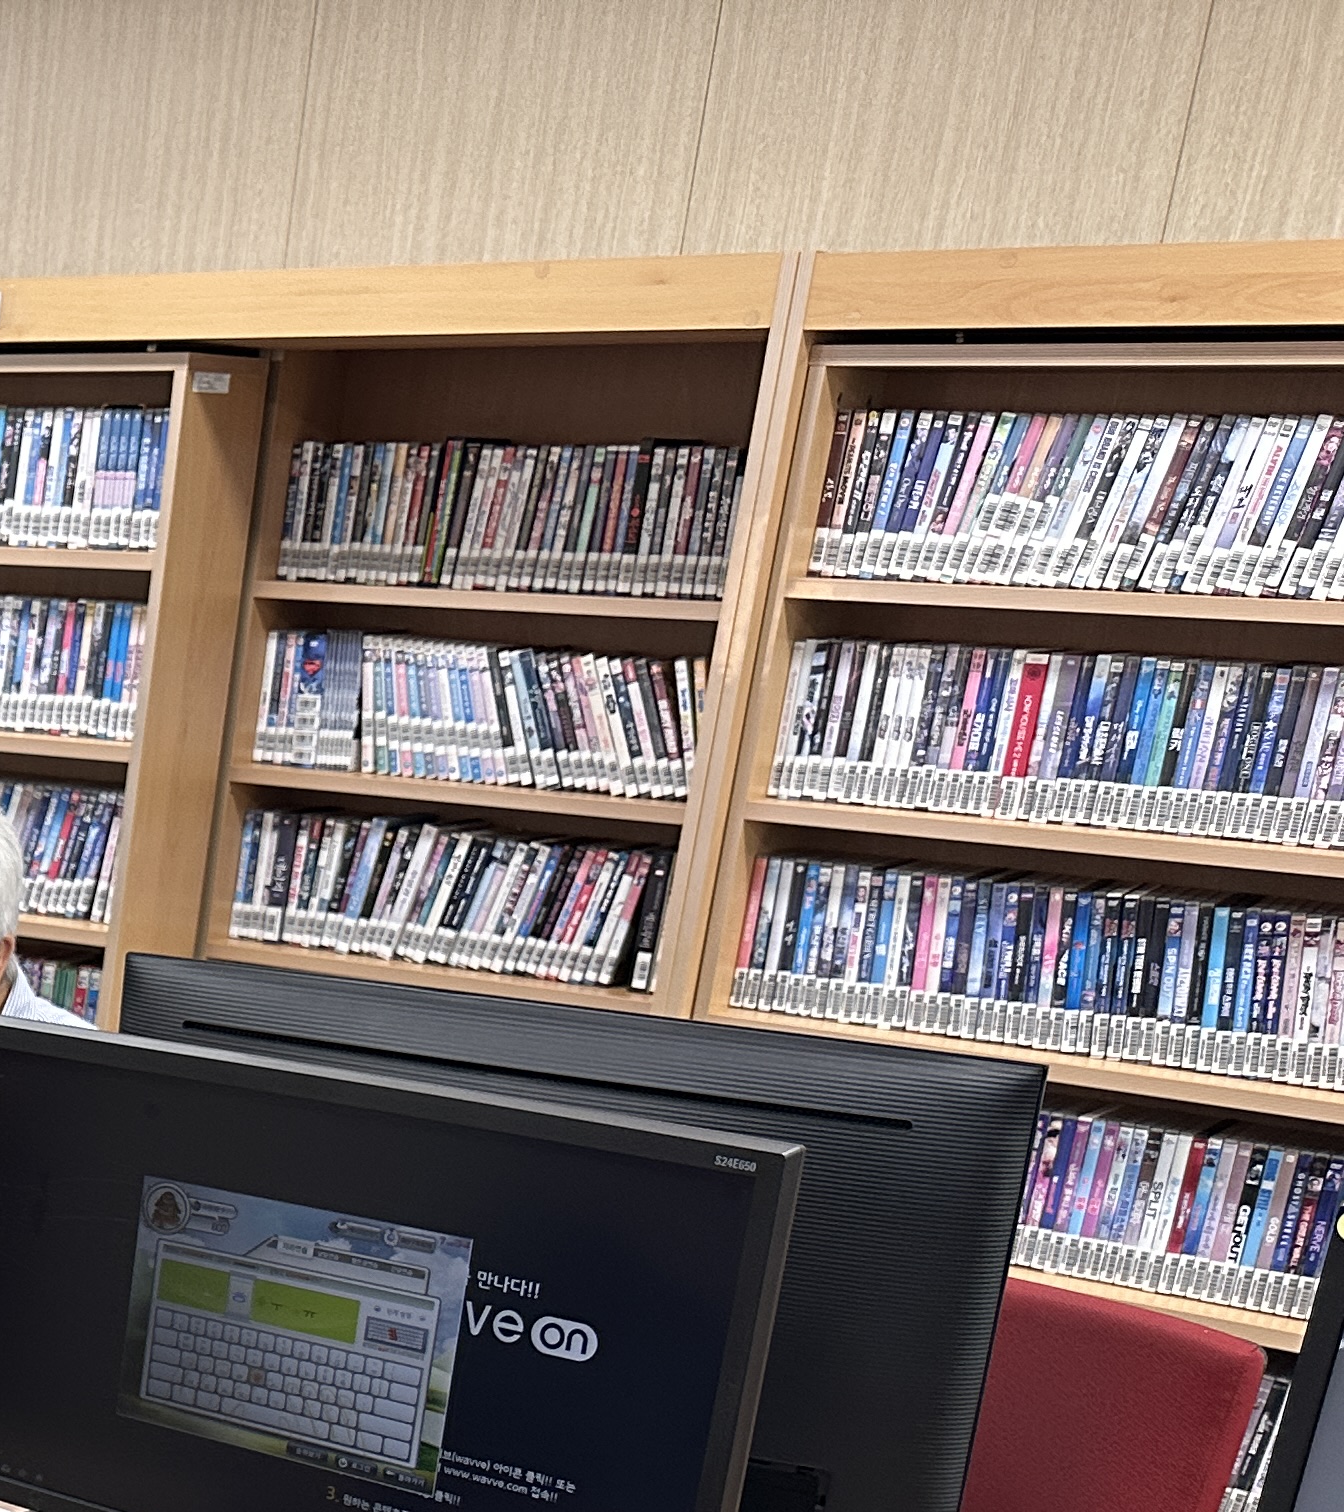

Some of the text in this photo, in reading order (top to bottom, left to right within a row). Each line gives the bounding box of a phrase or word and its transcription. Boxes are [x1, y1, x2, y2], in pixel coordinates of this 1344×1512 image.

[1145, 1181, 1164, 1220] SPLIT
[1228, 1205, 1251, 1263] GET OUT
[1265, 1217, 1279, 1242] GOLD
[1309, 1221, 1326, 1252] NERVE
[477, 1270, 541, 1299] 만나다!!
[539, 1322, 588, 1355] on
[443, 1465, 558, 1503] www.wavve.com 접속!!
[492, 1461, 523, 1480] 아이콘
[525, 1470, 553, 1487] 클릭!!
[555, 1478, 577, 1494] 또는
[343, 1493, 370, 1511] 원하는
